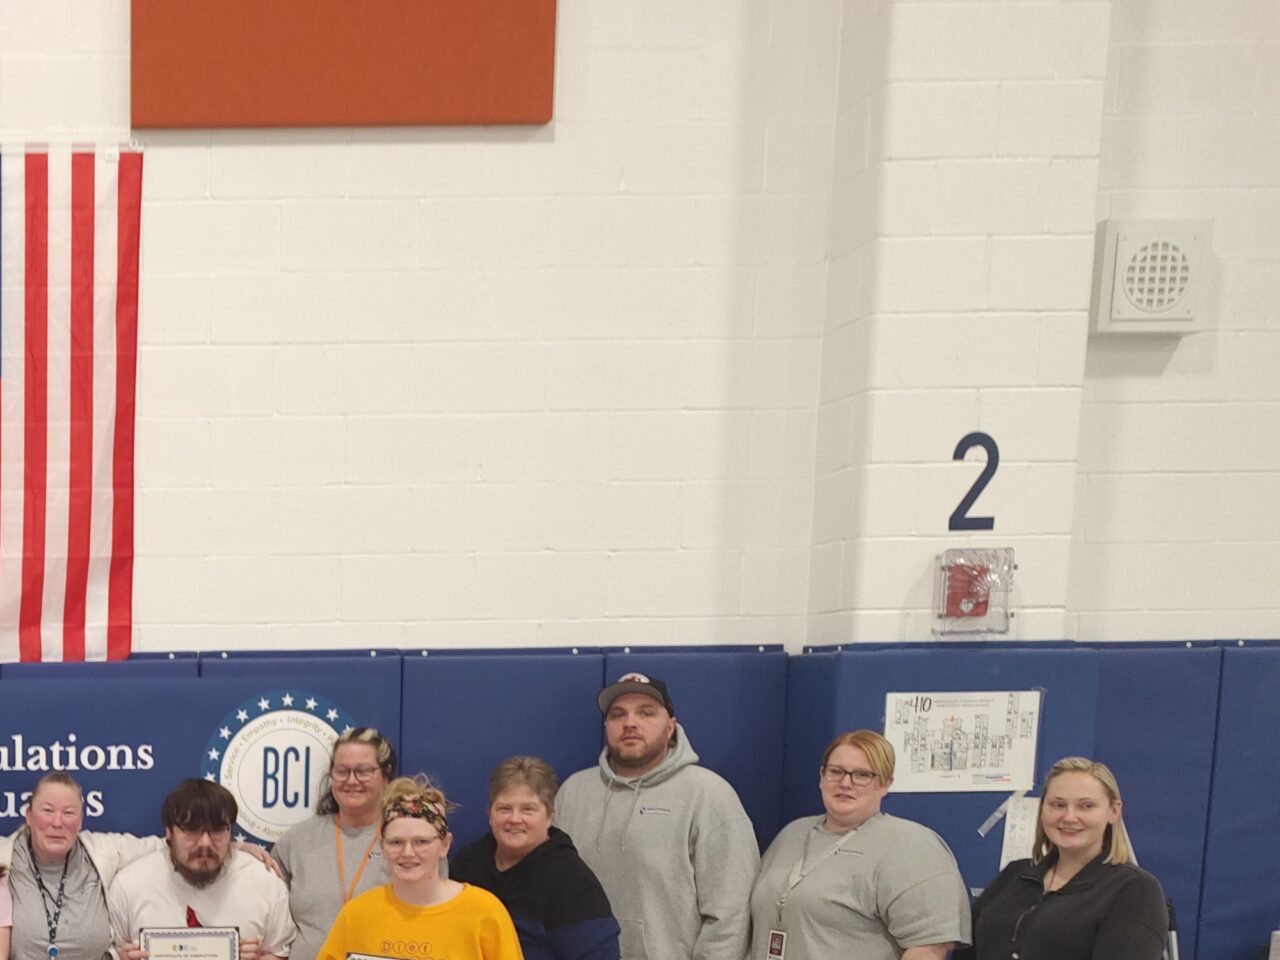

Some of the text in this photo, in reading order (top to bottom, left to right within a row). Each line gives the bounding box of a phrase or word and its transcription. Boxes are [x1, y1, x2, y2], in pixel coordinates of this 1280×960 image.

[948, 431, 999, 531] 2
[241, 718, 277, 743] Empathy
[287, 716, 323, 735] Integrity
[262, 746, 310, 808] BCI
